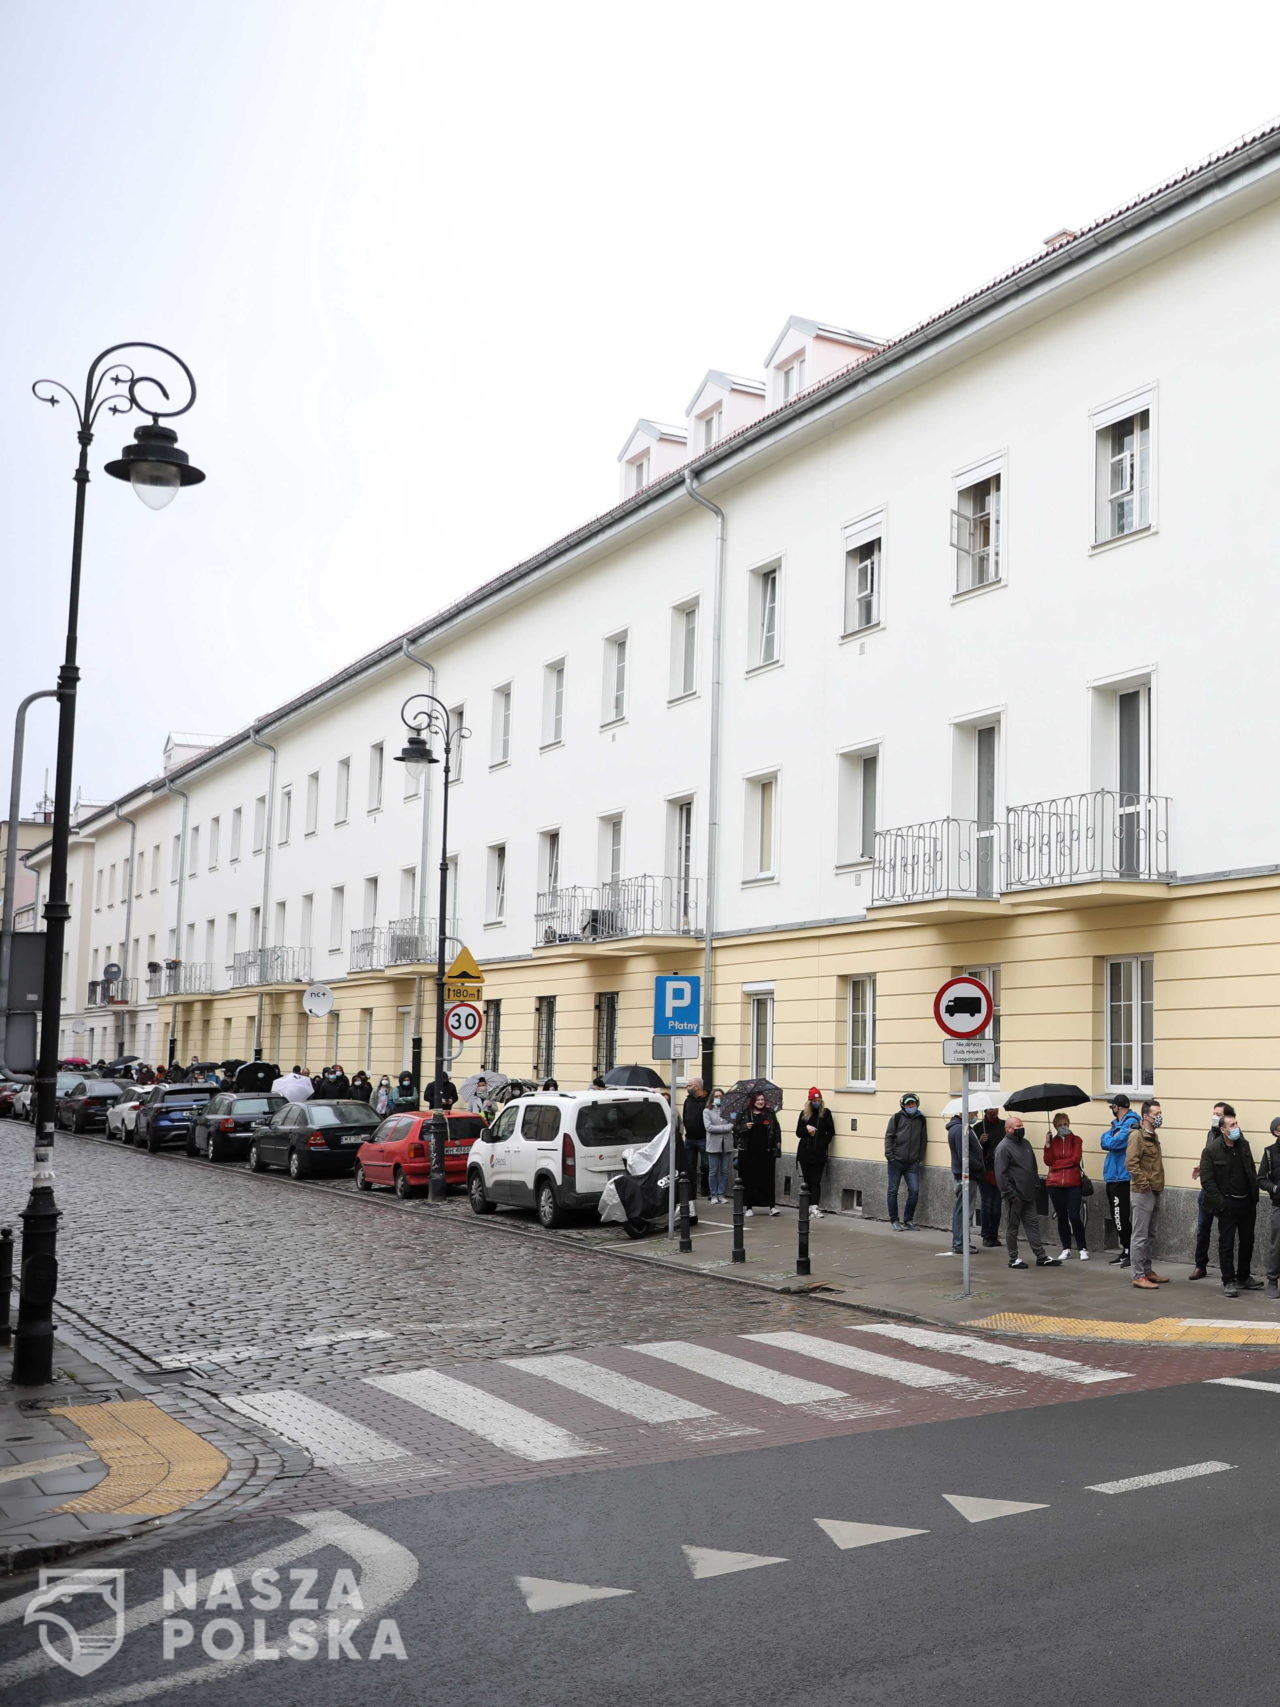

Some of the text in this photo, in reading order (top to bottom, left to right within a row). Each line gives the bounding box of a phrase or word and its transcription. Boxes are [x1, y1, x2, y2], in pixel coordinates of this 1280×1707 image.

[665, 981, 691, 1017] P
[450, 1012, 477, 1030] 30
[668, 1021, 698, 1032] Płatny
[1114, 1206, 1122, 1231] adidas
